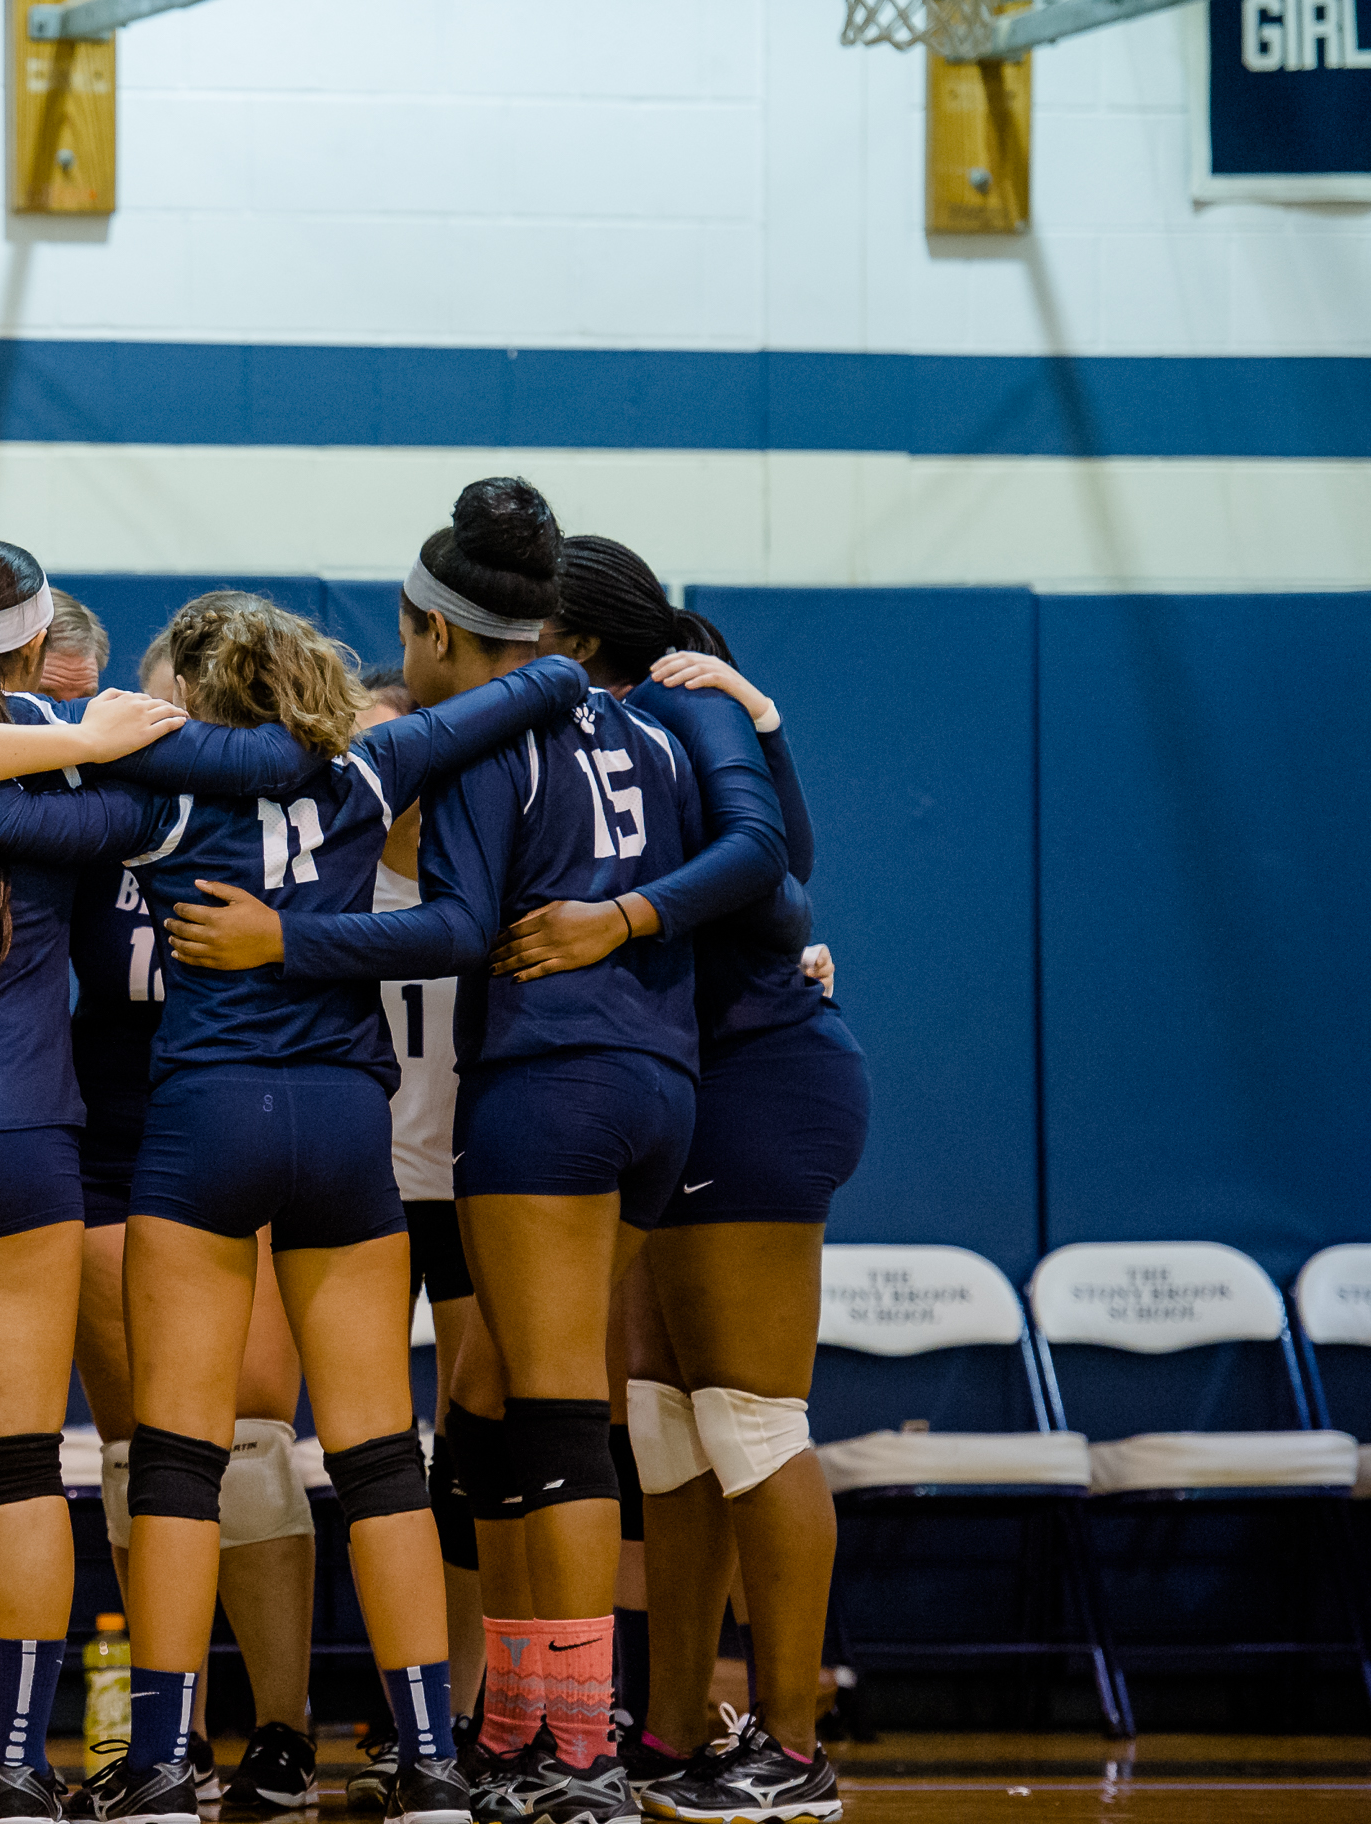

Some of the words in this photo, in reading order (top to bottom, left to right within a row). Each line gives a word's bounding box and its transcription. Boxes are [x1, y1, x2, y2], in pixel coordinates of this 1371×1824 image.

[257, 797, 324, 889] 11
[574, 748, 647, 859] 15
[129, 925, 166, 1002] 1
[402, 984, 424, 1058] 1
